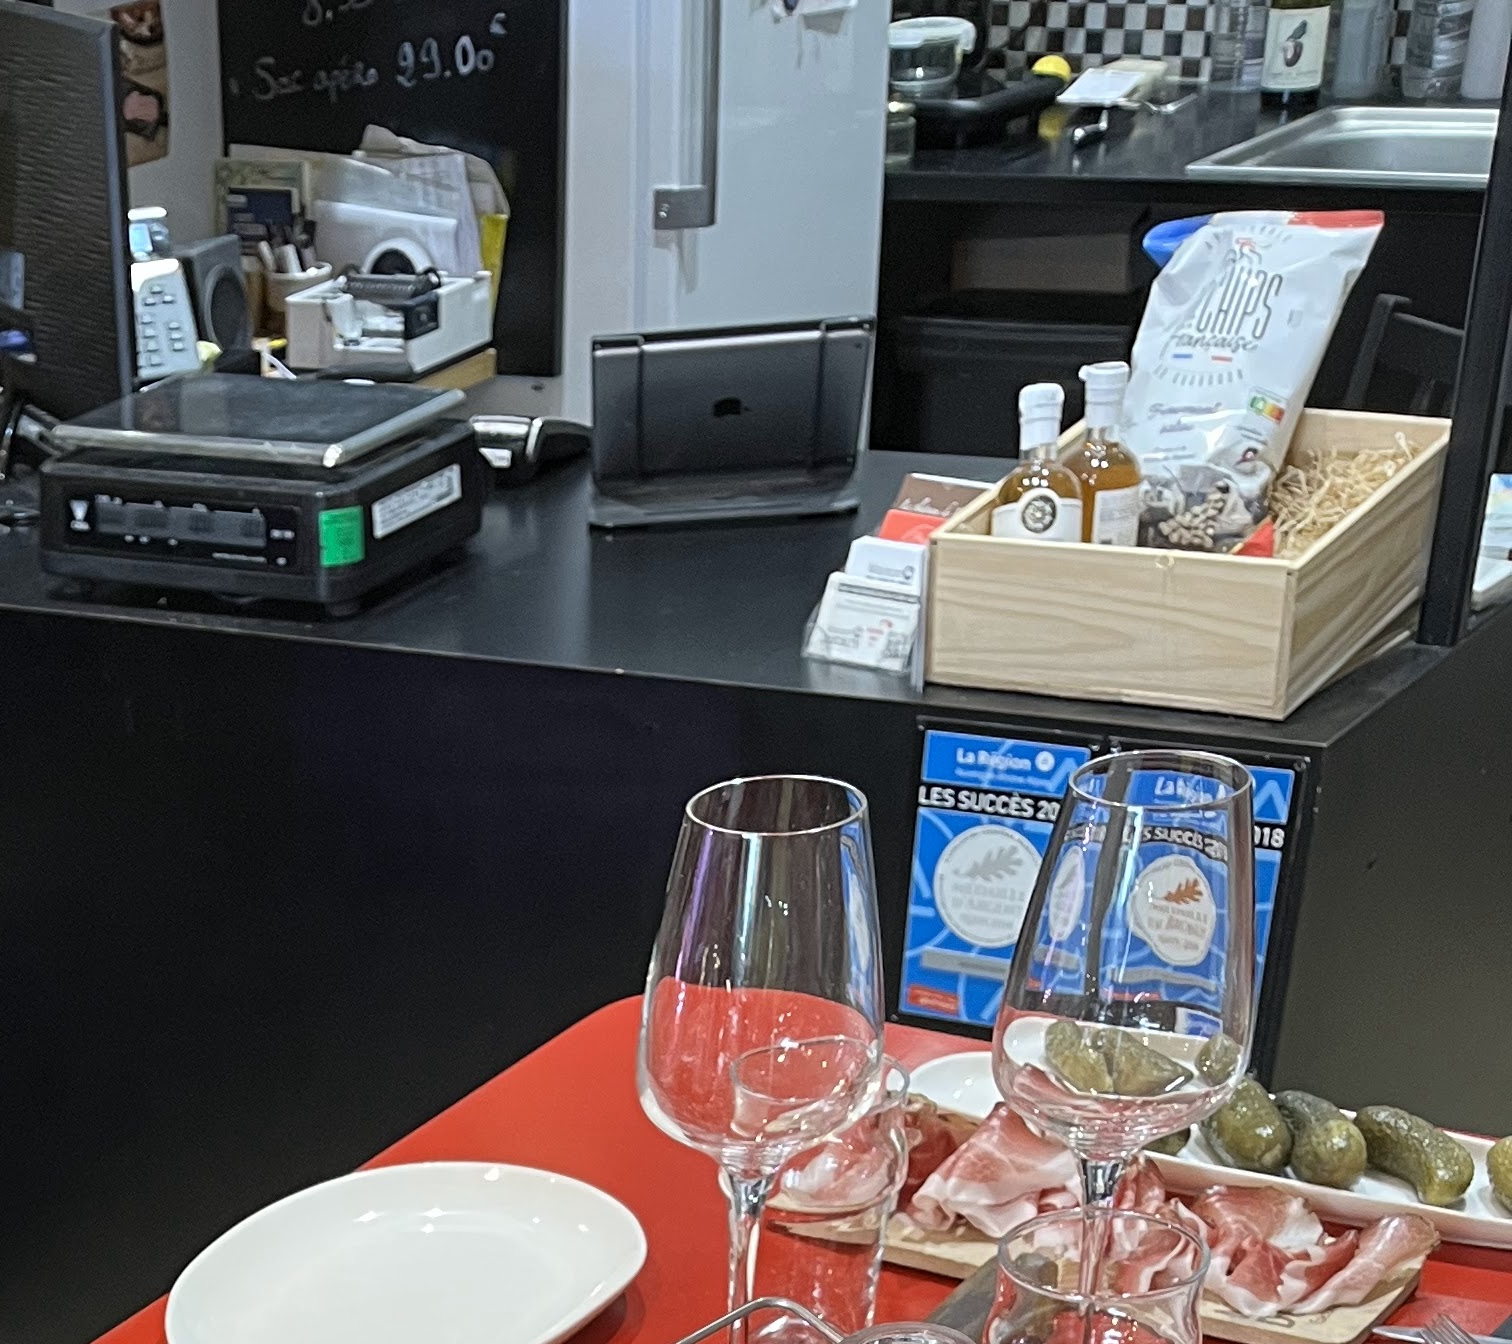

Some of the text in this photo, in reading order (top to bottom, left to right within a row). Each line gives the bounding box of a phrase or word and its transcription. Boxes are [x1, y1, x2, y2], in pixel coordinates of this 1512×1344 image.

[1196, 265, 1283, 341] CHIPS
[956, 747, 976, 765] La
[918, 785, 1061, 822] LES SUCCÈS 20
